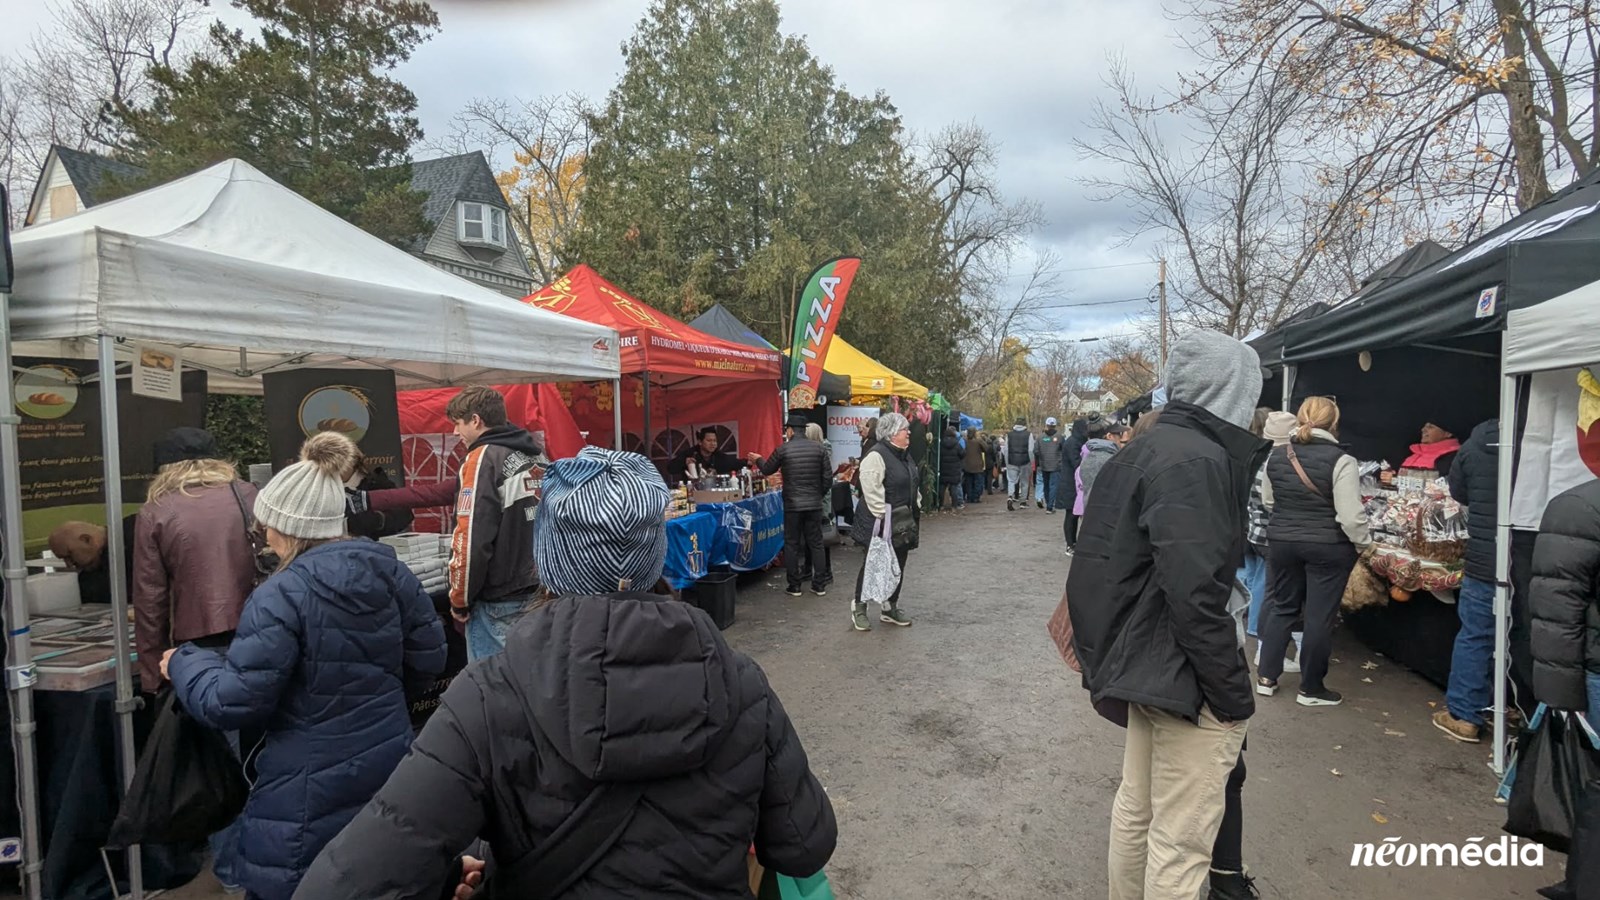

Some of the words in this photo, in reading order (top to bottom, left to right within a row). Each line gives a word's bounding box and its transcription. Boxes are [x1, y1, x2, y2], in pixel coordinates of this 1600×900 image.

[797, 276, 841, 382] PIZZA
[619, 336, 638, 347] IRE
[651, 335, 685, 350] HYDROMEL
[695, 359, 756, 372] www.mielnature.com
[828, 416, 865, 426] CUCIN
[362, 455, 395, 464] erroir
